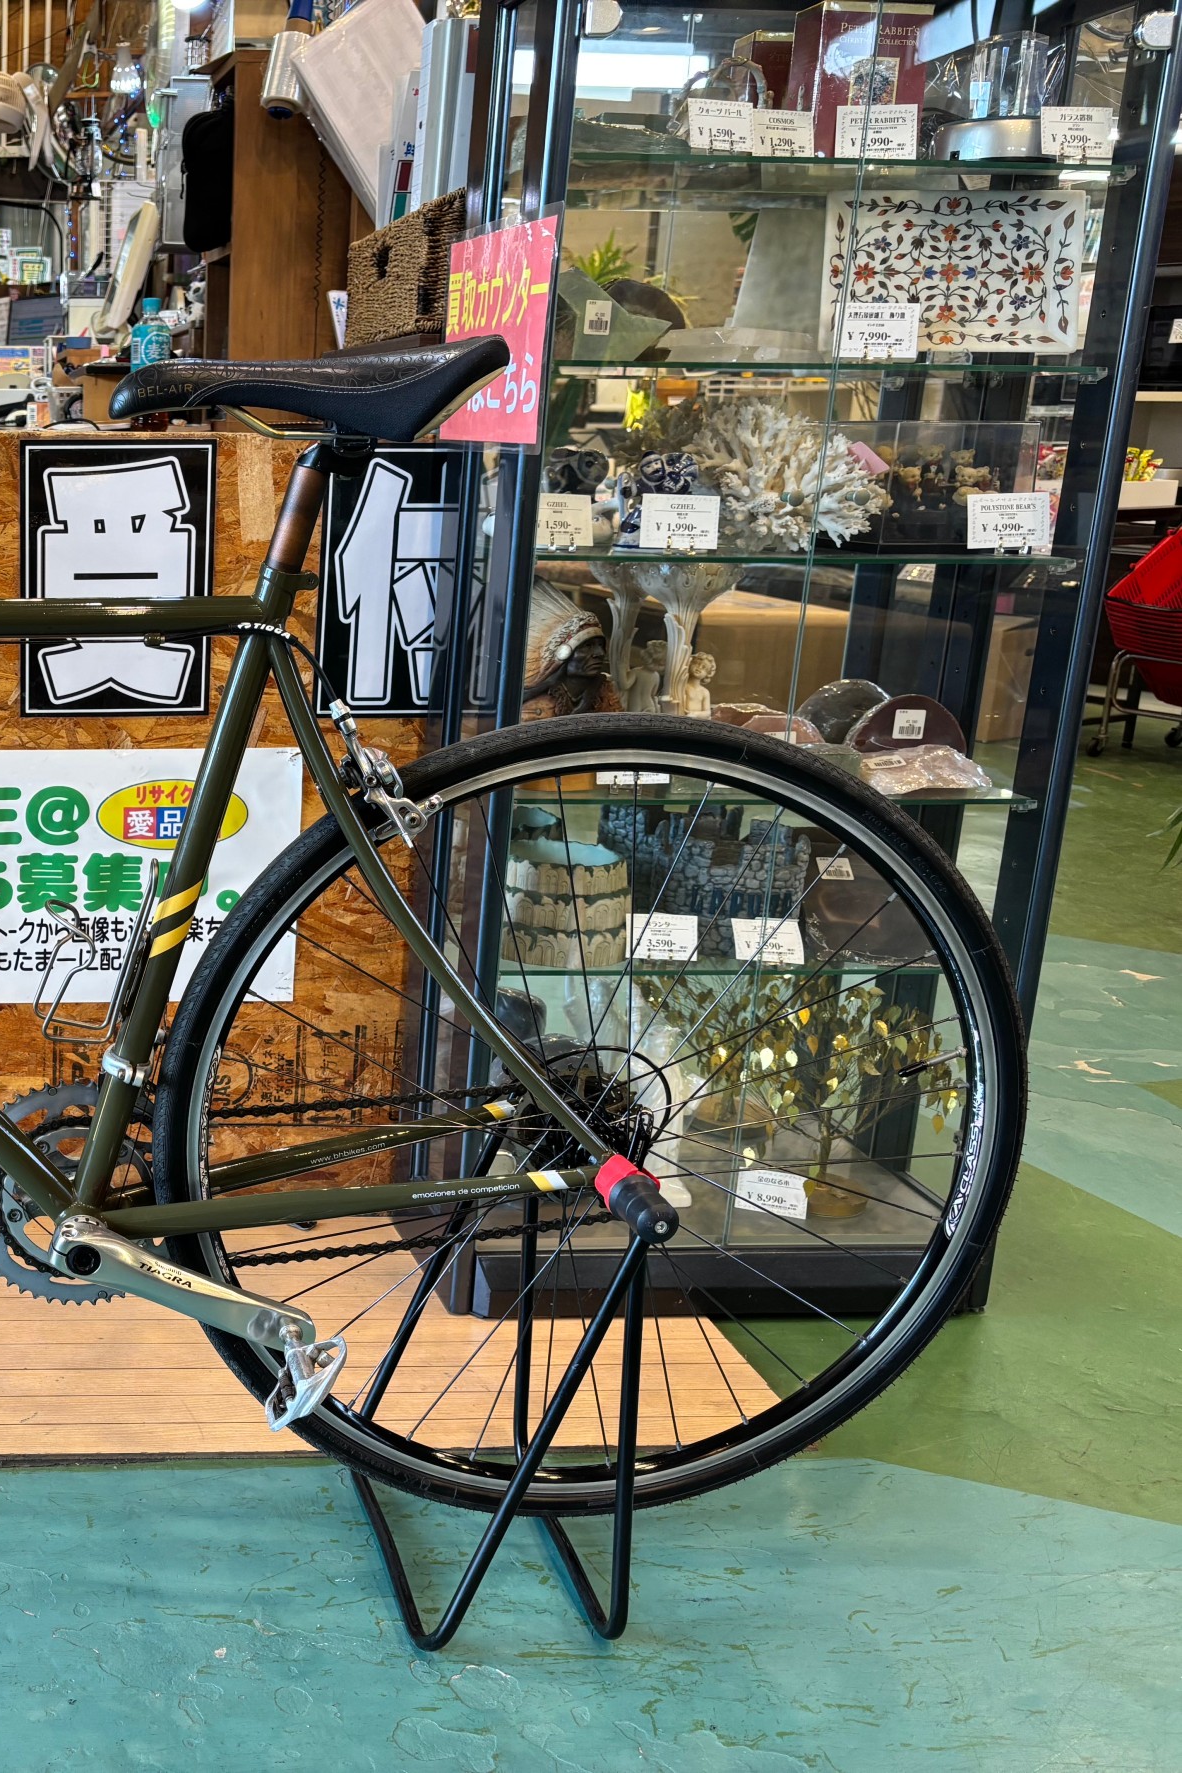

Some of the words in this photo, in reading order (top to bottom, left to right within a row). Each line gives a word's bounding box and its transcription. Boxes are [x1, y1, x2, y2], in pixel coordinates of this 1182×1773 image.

[768, 117, 795, 126] COSMOS
[850, 117, 872, 125] PETR
[874, 116, 907, 125] RABBIT'S
[867, 137, 894, 149] ,990-
[446, 258, 550, 337] 買取カウンター
[137, 384, 194, 399] BEL-AIR
[670, 503, 696, 511] GZHEL
[980, 503, 1015, 512] POLYSTONE
[135, 784, 193, 806] リサイク
[126, 810, 184, 840] 愛品
[310, 1141, 386, 1165] www.bhbikes.com
[412, 1188, 456, 1200] emociones
[457, 1187, 469, 1197] de
[470, 1183, 520, 1197] competicion
[138, 1261, 193, 1289] TIAGRA
